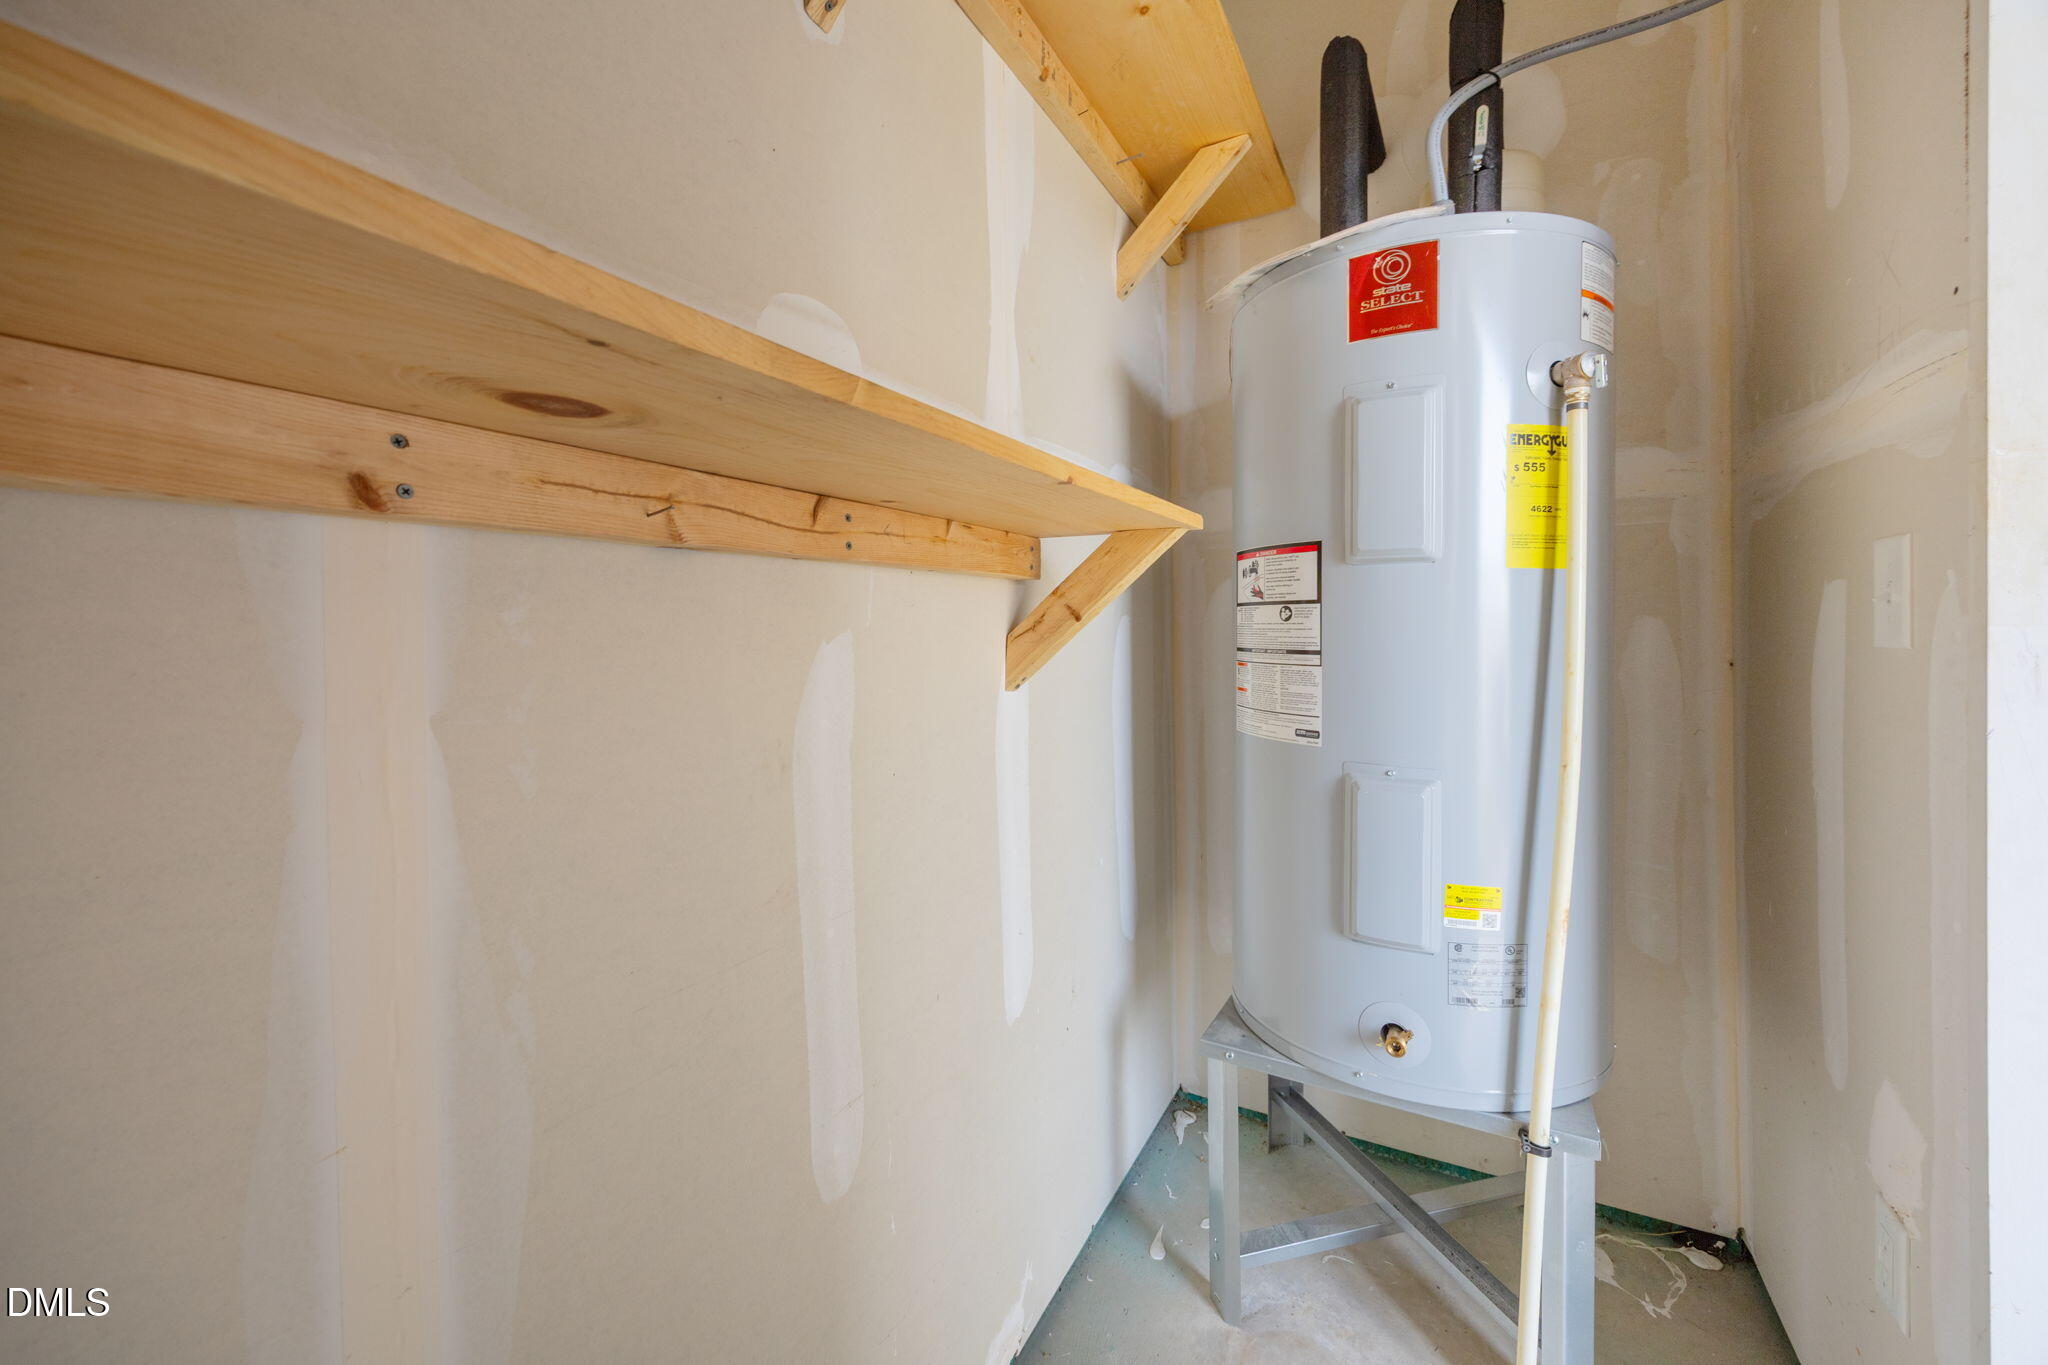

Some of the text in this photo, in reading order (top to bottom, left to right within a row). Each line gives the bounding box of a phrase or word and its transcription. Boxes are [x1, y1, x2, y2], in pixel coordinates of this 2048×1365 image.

[1372, 283, 1412, 297] state
[1360, 290, 1424, 310] SELECT
[1523, 461, 1546, 472] 555
[1530, 505, 1553, 513] 4622
